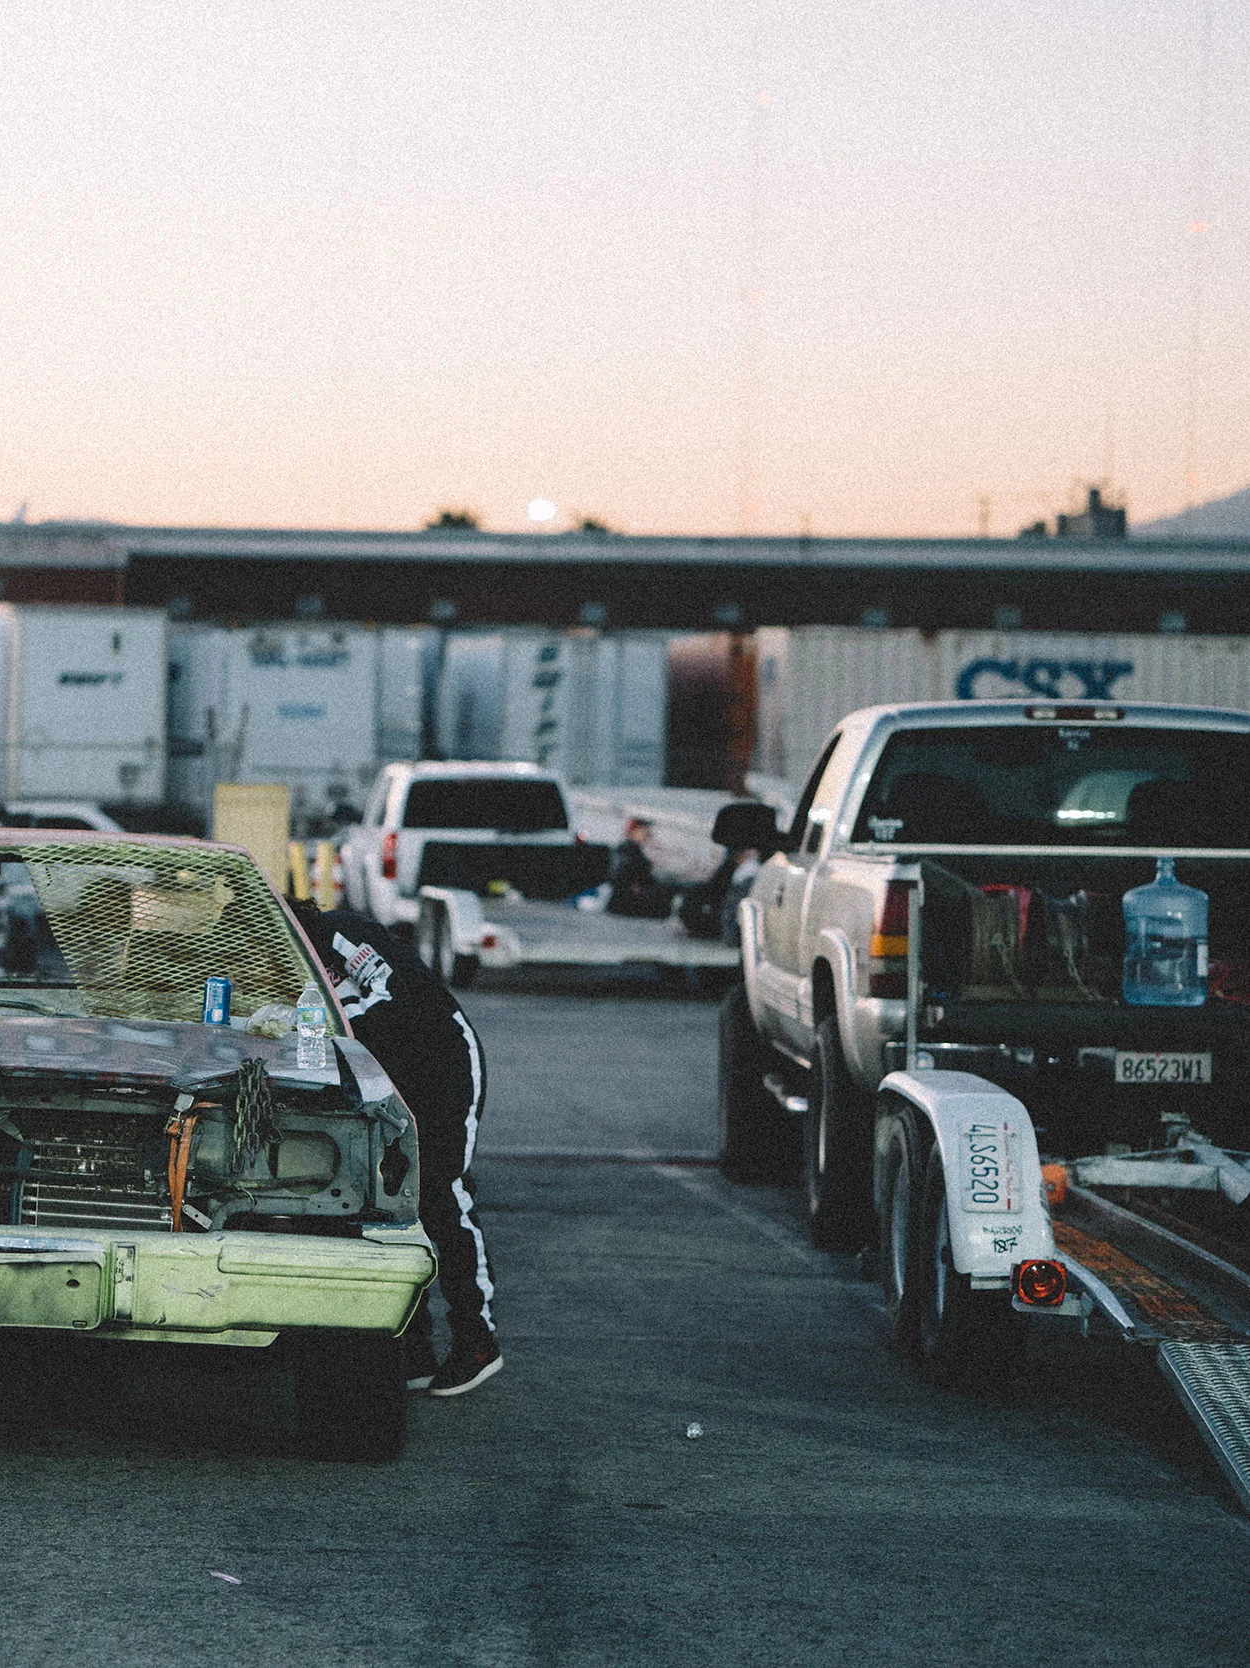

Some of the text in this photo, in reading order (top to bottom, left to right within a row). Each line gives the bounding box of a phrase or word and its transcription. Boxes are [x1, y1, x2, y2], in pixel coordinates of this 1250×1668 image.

[956, 657, 1135, 700] CSX
[1122, 1058, 1203, 1081] 86523W1
[968, 1123, 999, 1204] 4LS6520
